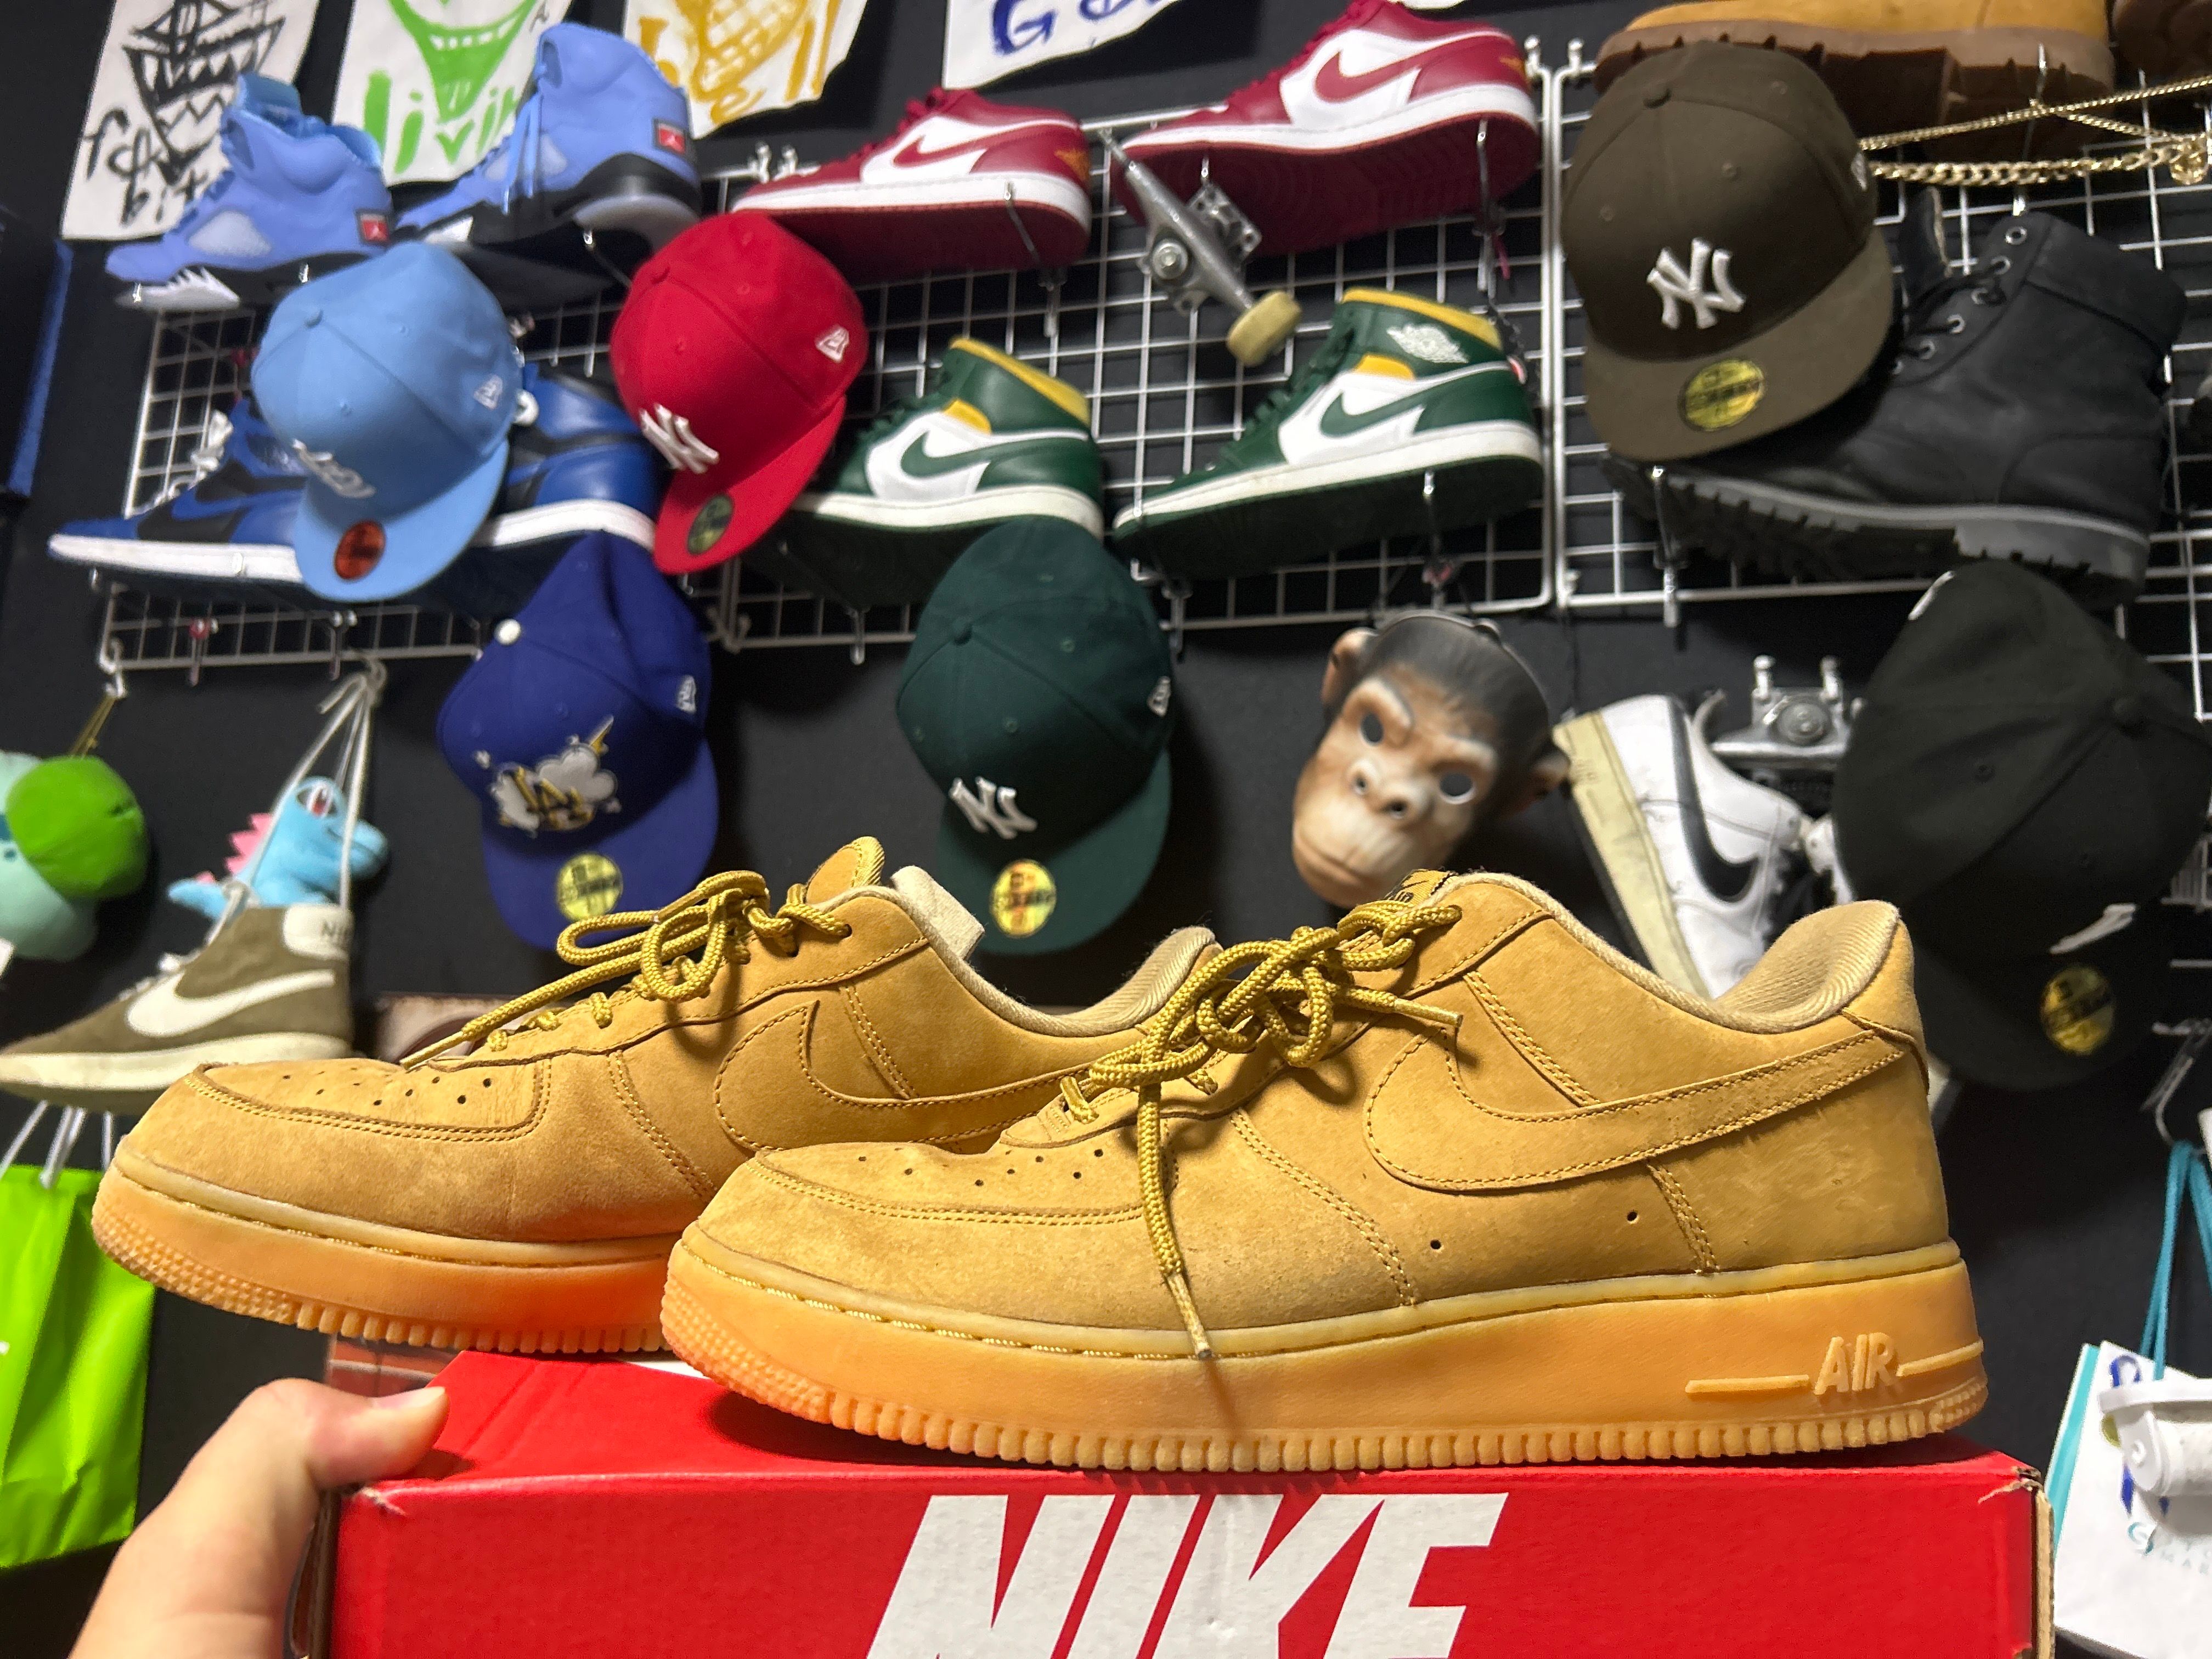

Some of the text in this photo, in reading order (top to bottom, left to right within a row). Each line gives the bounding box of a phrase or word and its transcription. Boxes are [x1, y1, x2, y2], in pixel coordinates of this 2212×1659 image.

[1647, 238, 1746, 330] NY
[948, 776, 1038, 840] NY
[1813, 1331, 1899, 1395] AIR
[866, 1492, 1509, 1659] NIKE
